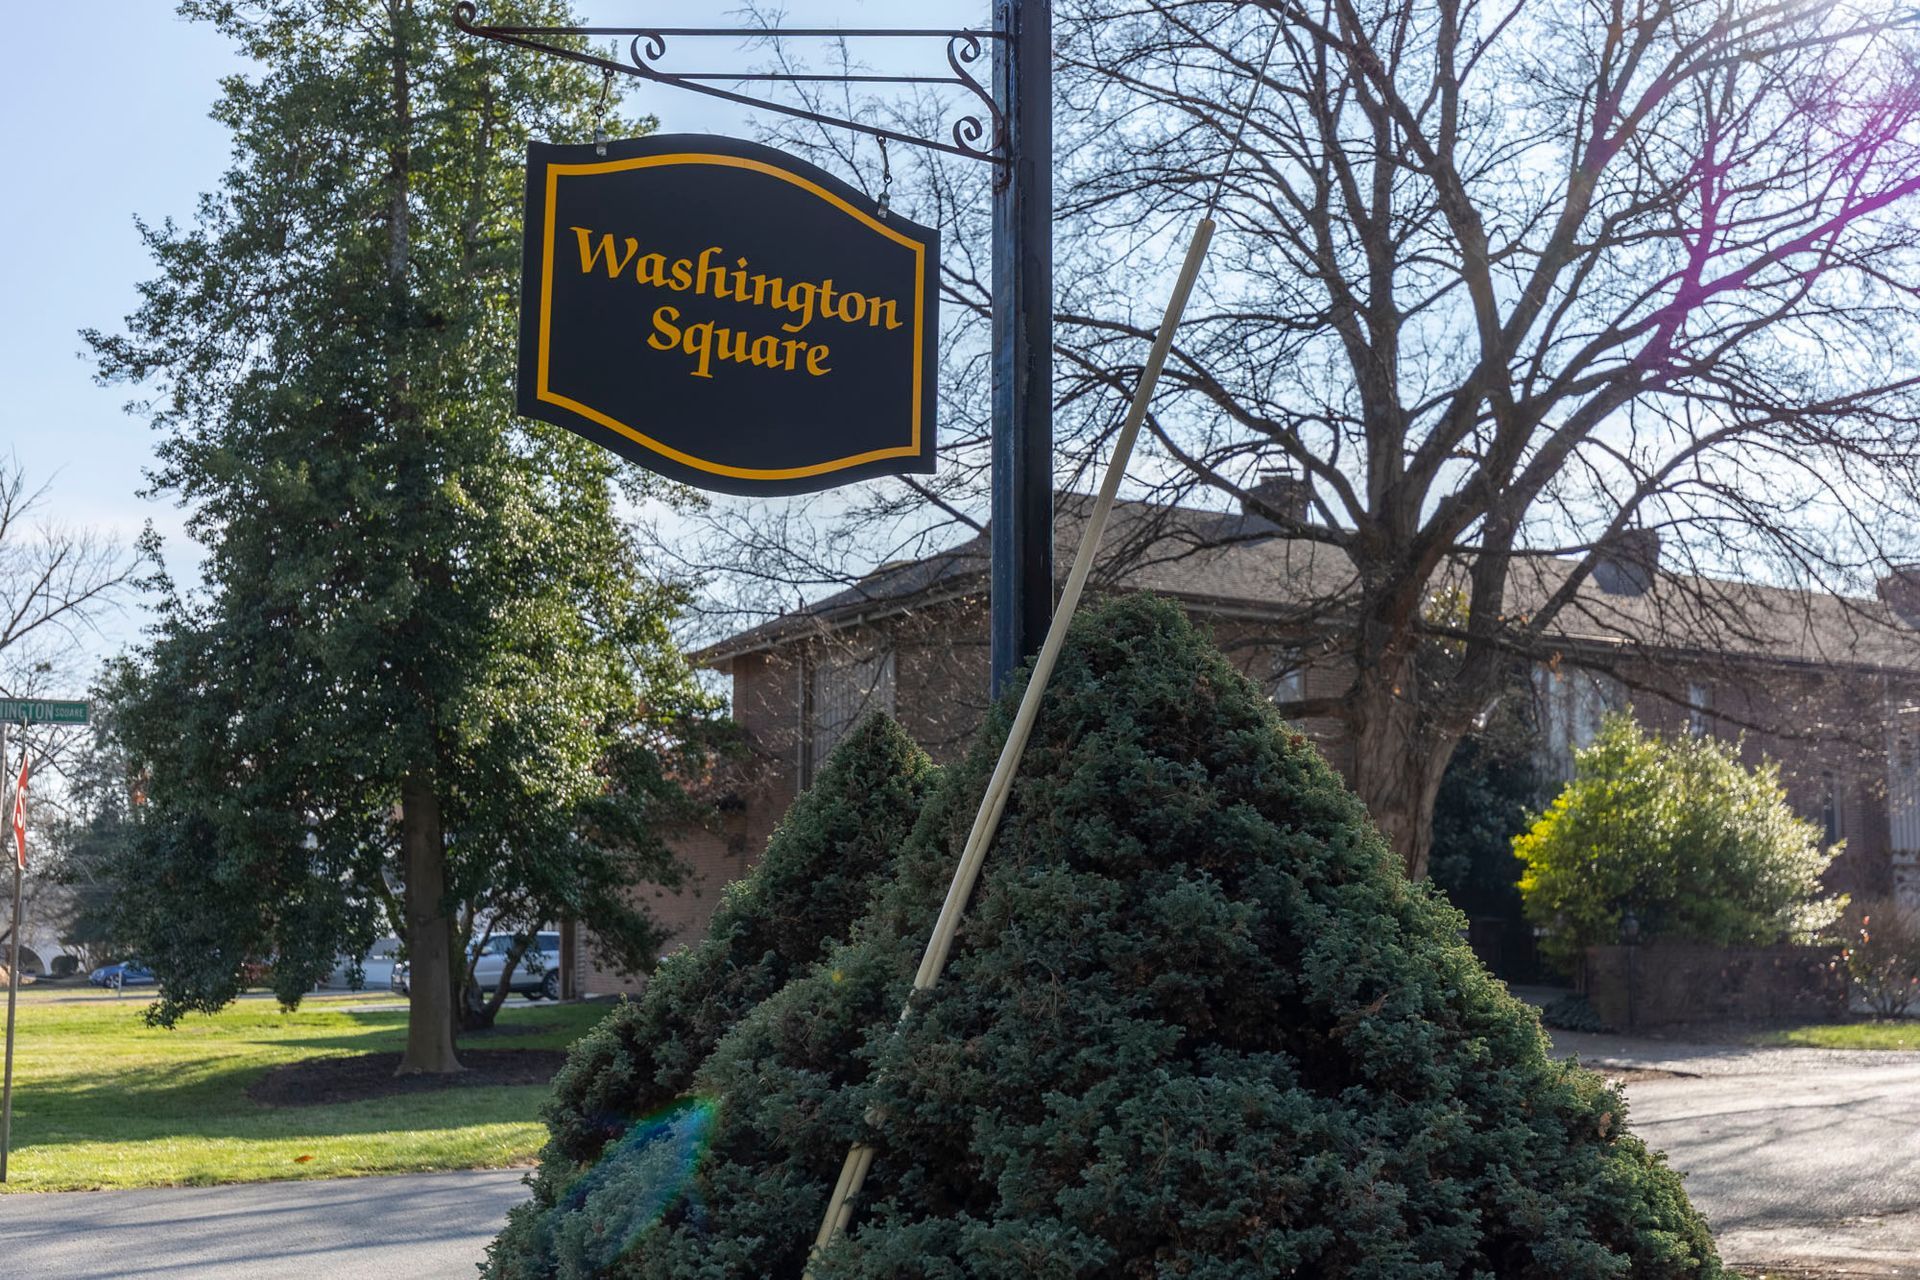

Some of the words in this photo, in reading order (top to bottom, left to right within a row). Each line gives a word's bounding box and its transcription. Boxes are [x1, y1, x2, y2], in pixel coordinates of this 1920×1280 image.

[570, 226, 904, 333] Washington
[646, 306, 832, 379] Square
[55, 707, 84, 718] SQUARE
